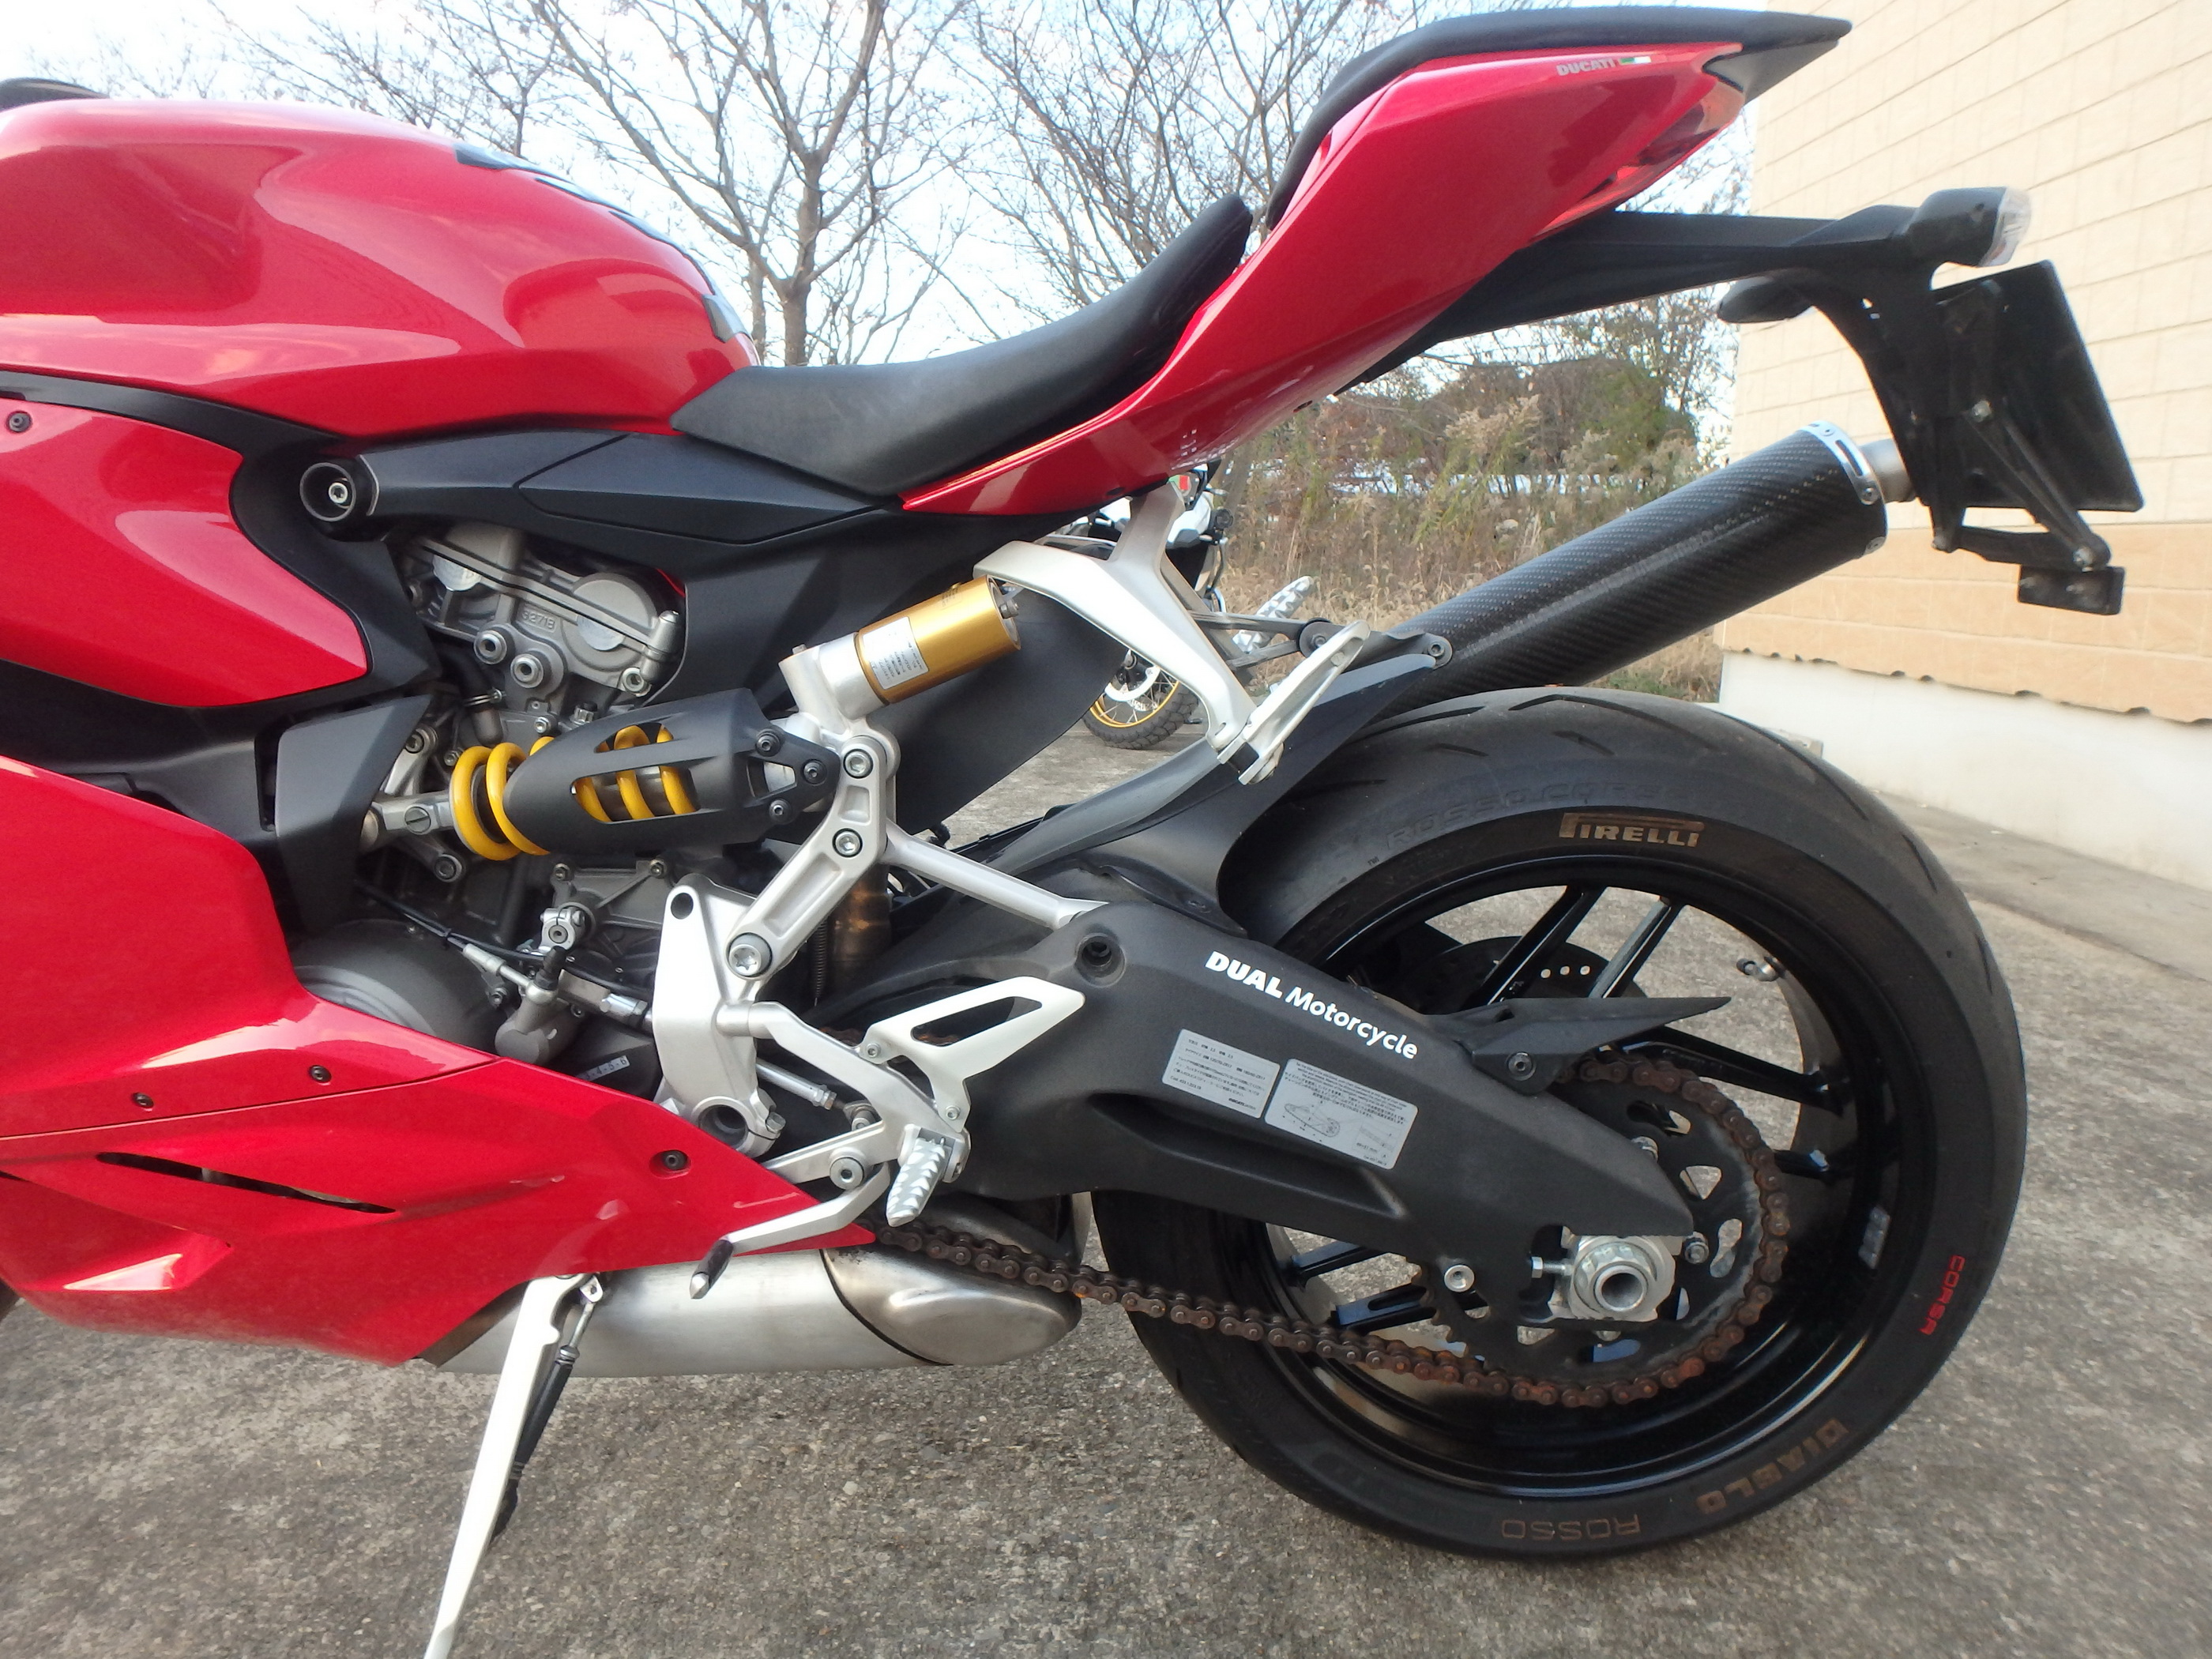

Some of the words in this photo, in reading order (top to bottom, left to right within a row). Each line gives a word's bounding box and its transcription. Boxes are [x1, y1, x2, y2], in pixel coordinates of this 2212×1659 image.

[1556, 58, 1616, 77] DUCATI
[1559, 812, 1705, 848] PIRELLI
[1205, 950, 1283, 999] DUAL
[1285, 986, 1418, 1059] Motorcycle
[1918, 1255, 1966, 1336] CORSA
[1695, 1418, 1849, 1515] DIABLO
[1503, 1514, 1642, 1541] ROSSO
